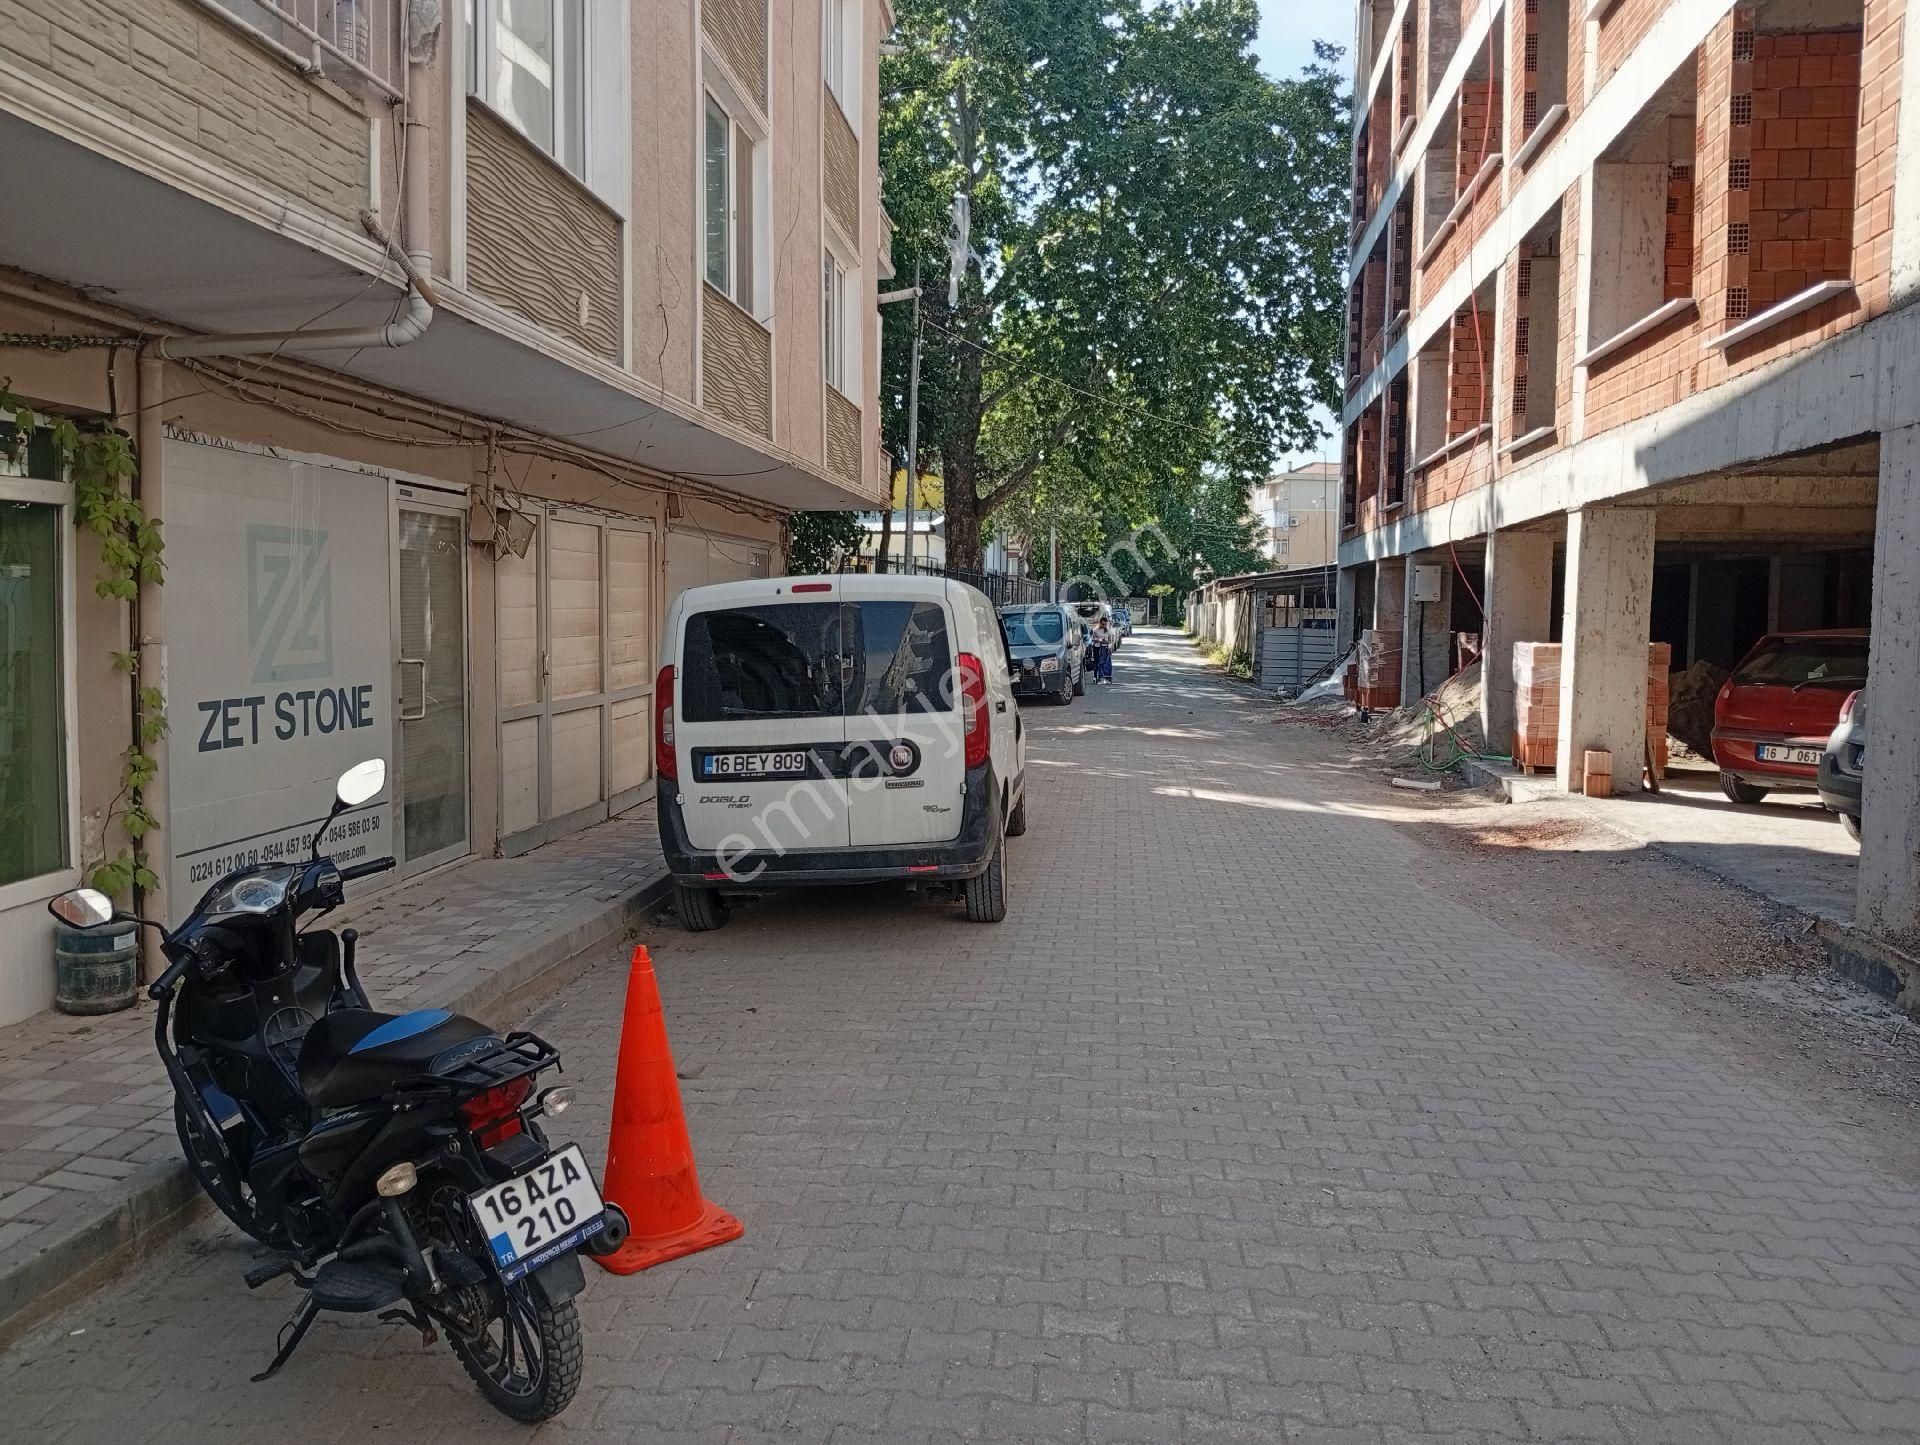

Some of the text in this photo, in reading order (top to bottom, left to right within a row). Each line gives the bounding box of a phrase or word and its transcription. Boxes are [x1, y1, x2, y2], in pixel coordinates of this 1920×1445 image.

[198, 684, 374, 752] ZET STONE
[714, 756, 730, 773] 16
[734, 754, 769, 772] BEY
[773, 753, 804, 771] 809
[1766, 748, 1777, 759] 16
[1784, 747, 1791, 759] J
[190, 861, 214, 883] 0224
[215, 855, 232, 876] 612
[235, 852, 246, 869] 00
[248, 849, 258, 866] 60
[286, 836, 300, 856] 457
[302, 833, 311, 851] 93
[329, 824, 347, 843] 0545
[348, 820, 361, 838] 586
[362, 817, 371, 834] 03
[372, 815, 380, 830] 50
[485, 1157, 581, 1223] 16 AZA
[517, 1197, 577, 1248] 210
[500, 1251, 515, 1265] TR
